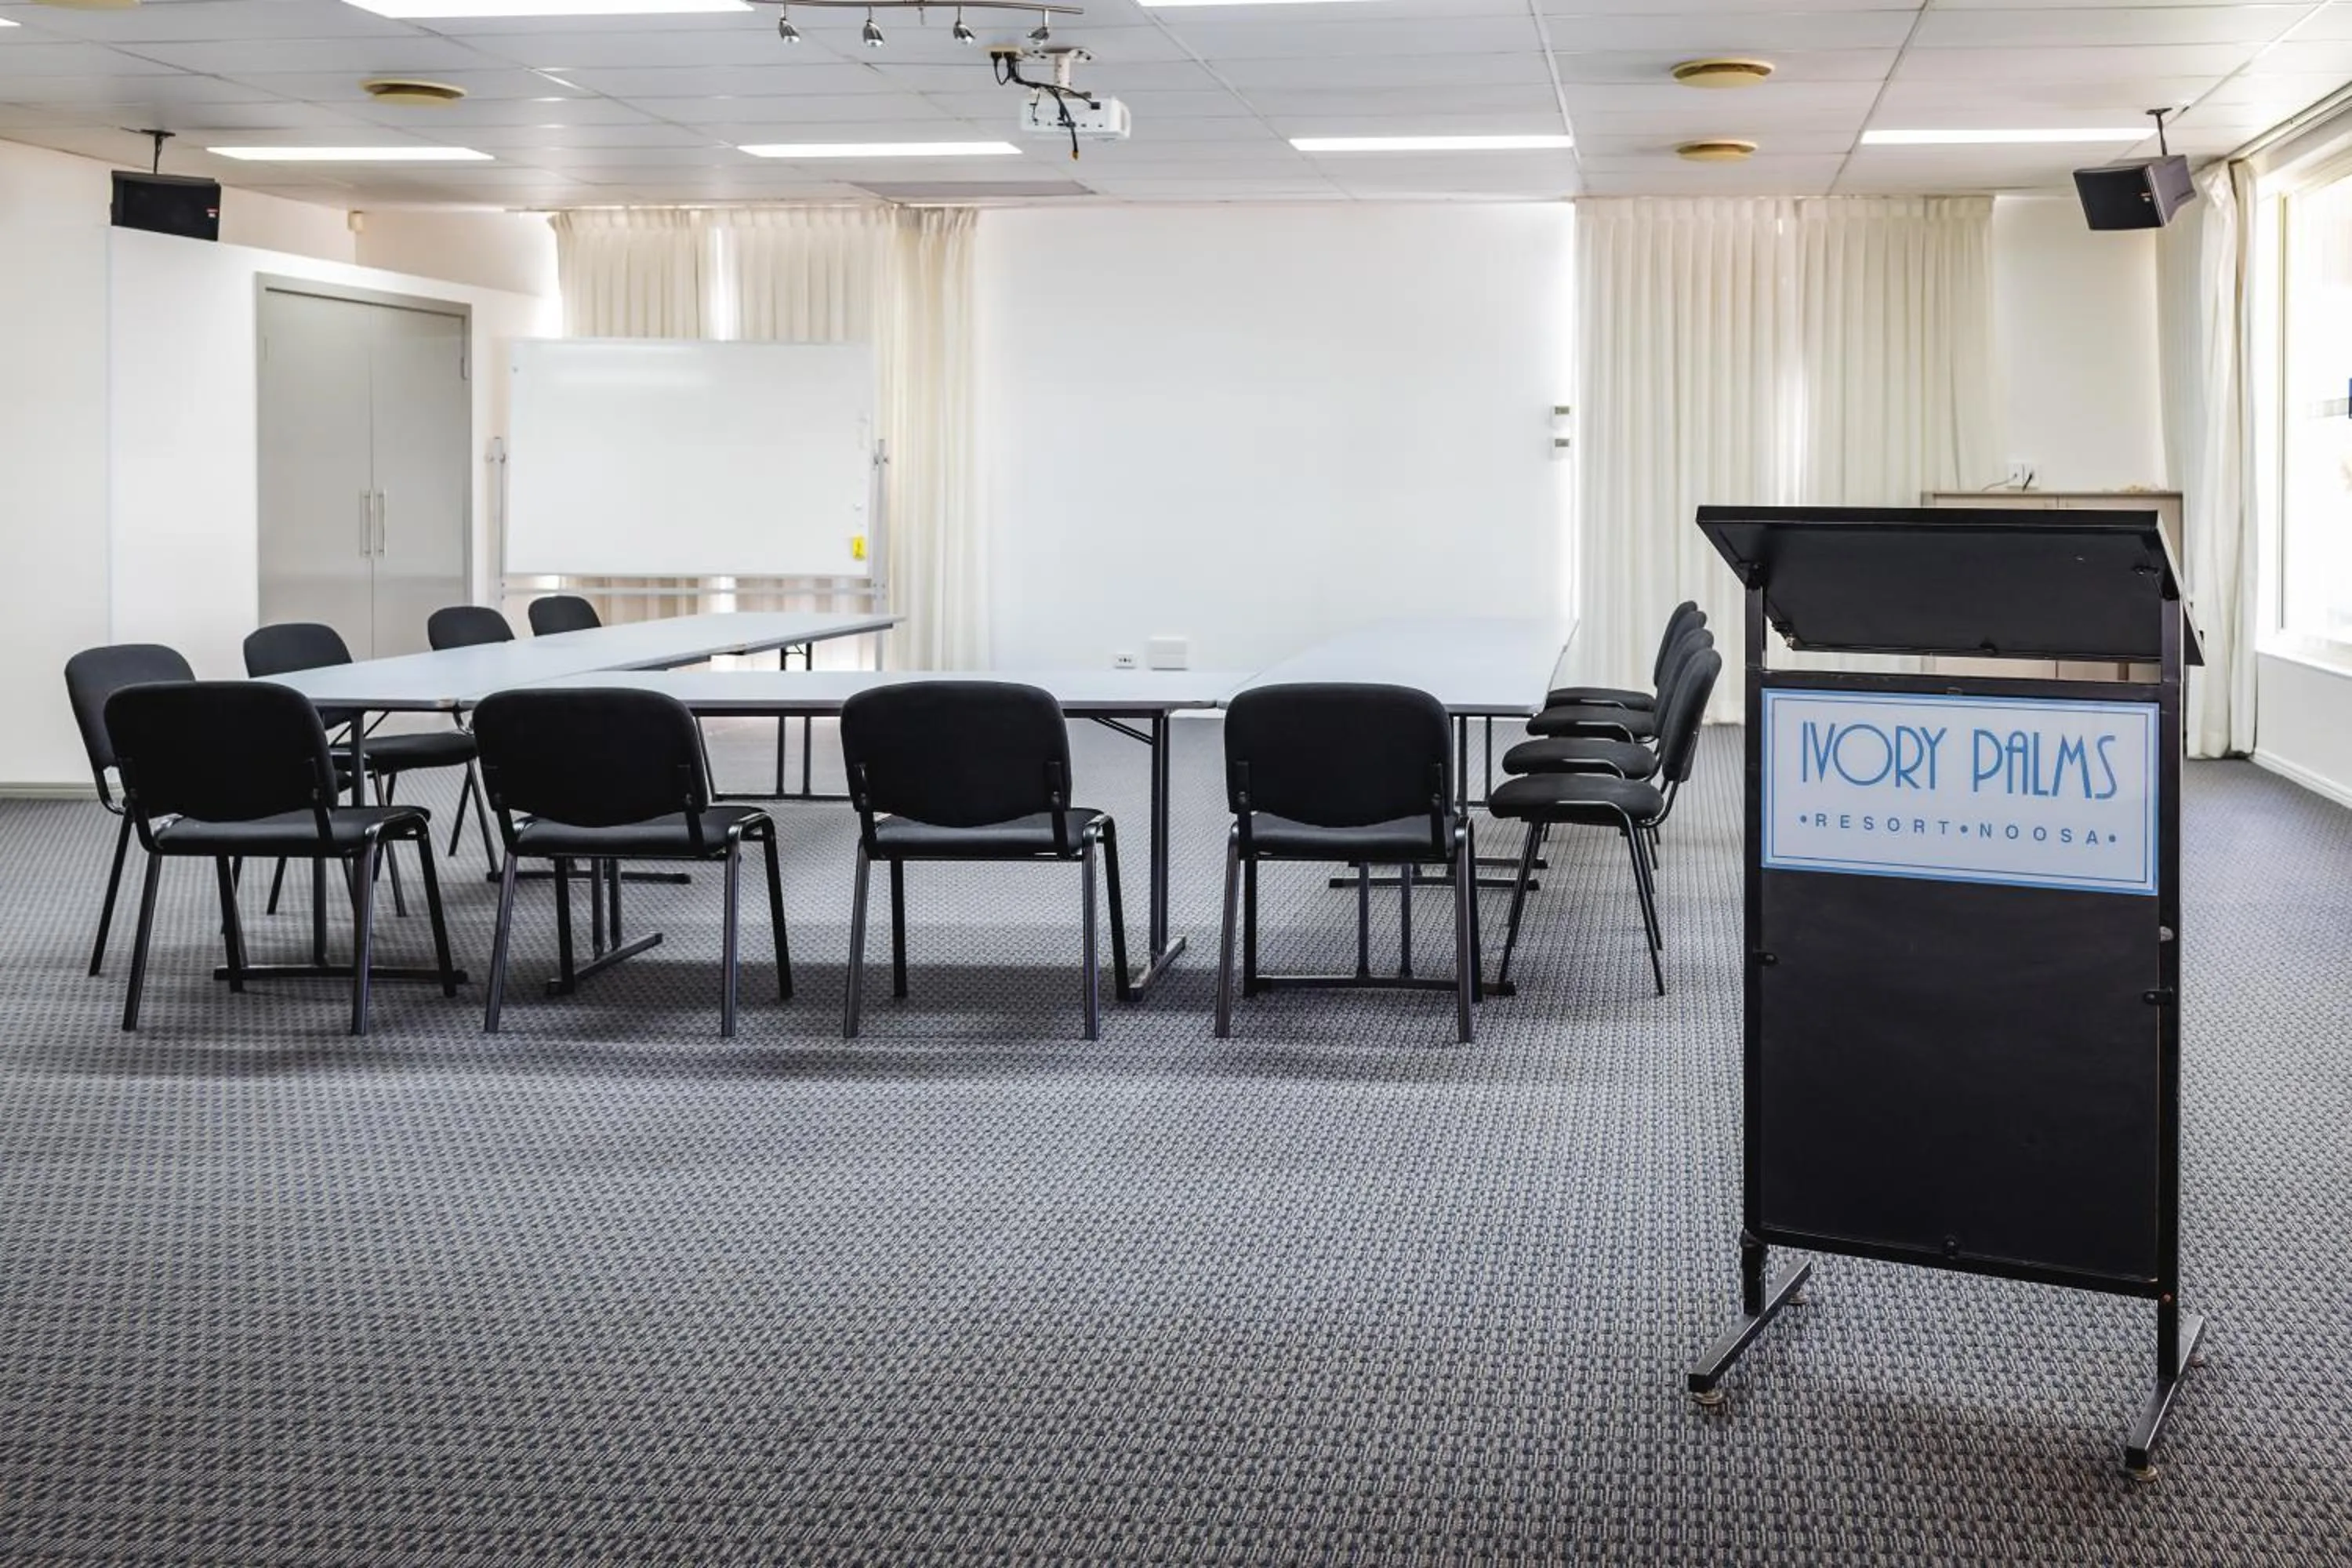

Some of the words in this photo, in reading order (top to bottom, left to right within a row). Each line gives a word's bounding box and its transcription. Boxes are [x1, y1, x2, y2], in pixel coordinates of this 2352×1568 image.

[1802, 720, 1948, 791] IVORY
[1972, 728, 2118, 800] PALMS
[1815, 812, 1951, 836] RESORT
[1978, 822, 2100, 846] NOOSA
